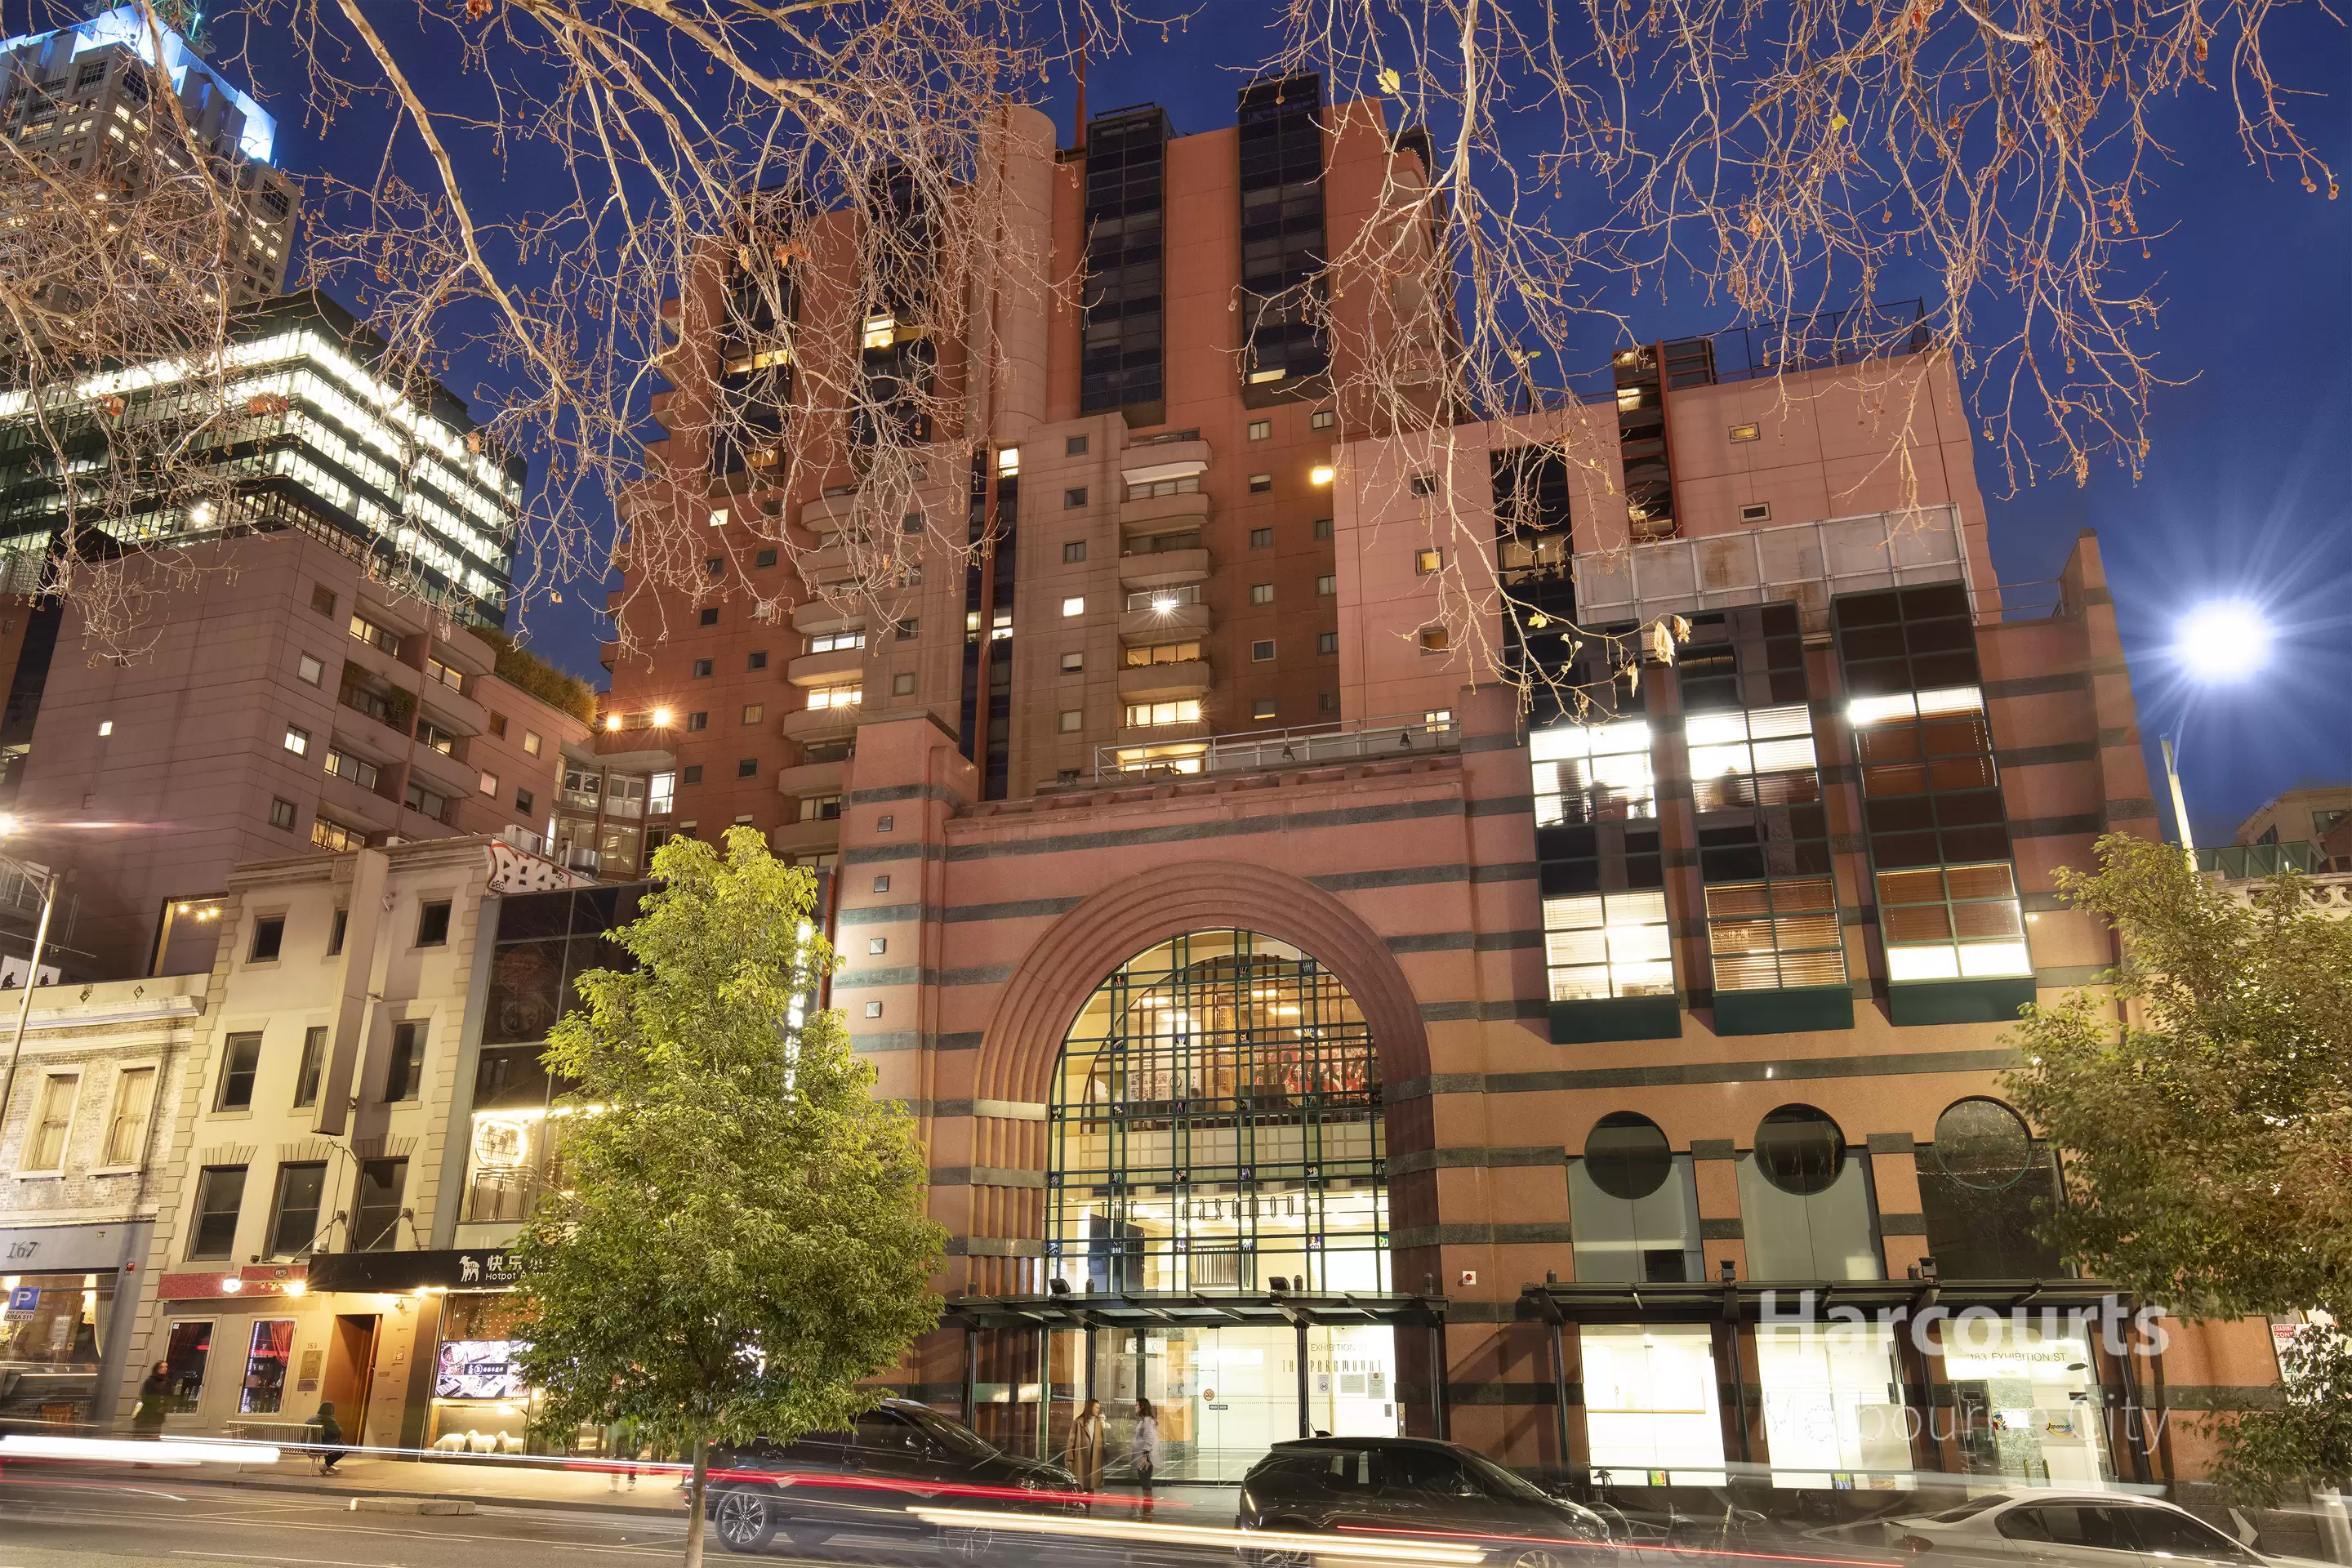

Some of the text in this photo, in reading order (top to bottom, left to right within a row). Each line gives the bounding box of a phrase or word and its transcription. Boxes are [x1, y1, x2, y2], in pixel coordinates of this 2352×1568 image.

[7, 1241, 38, 1258] 167
[485, 1272, 516, 1281] Hotpot
[15, 1291, 32, 1307] P
[1991, 1352, 2050, 1362] EXHIBITION
[2053, 1352, 2066, 1361] ST
